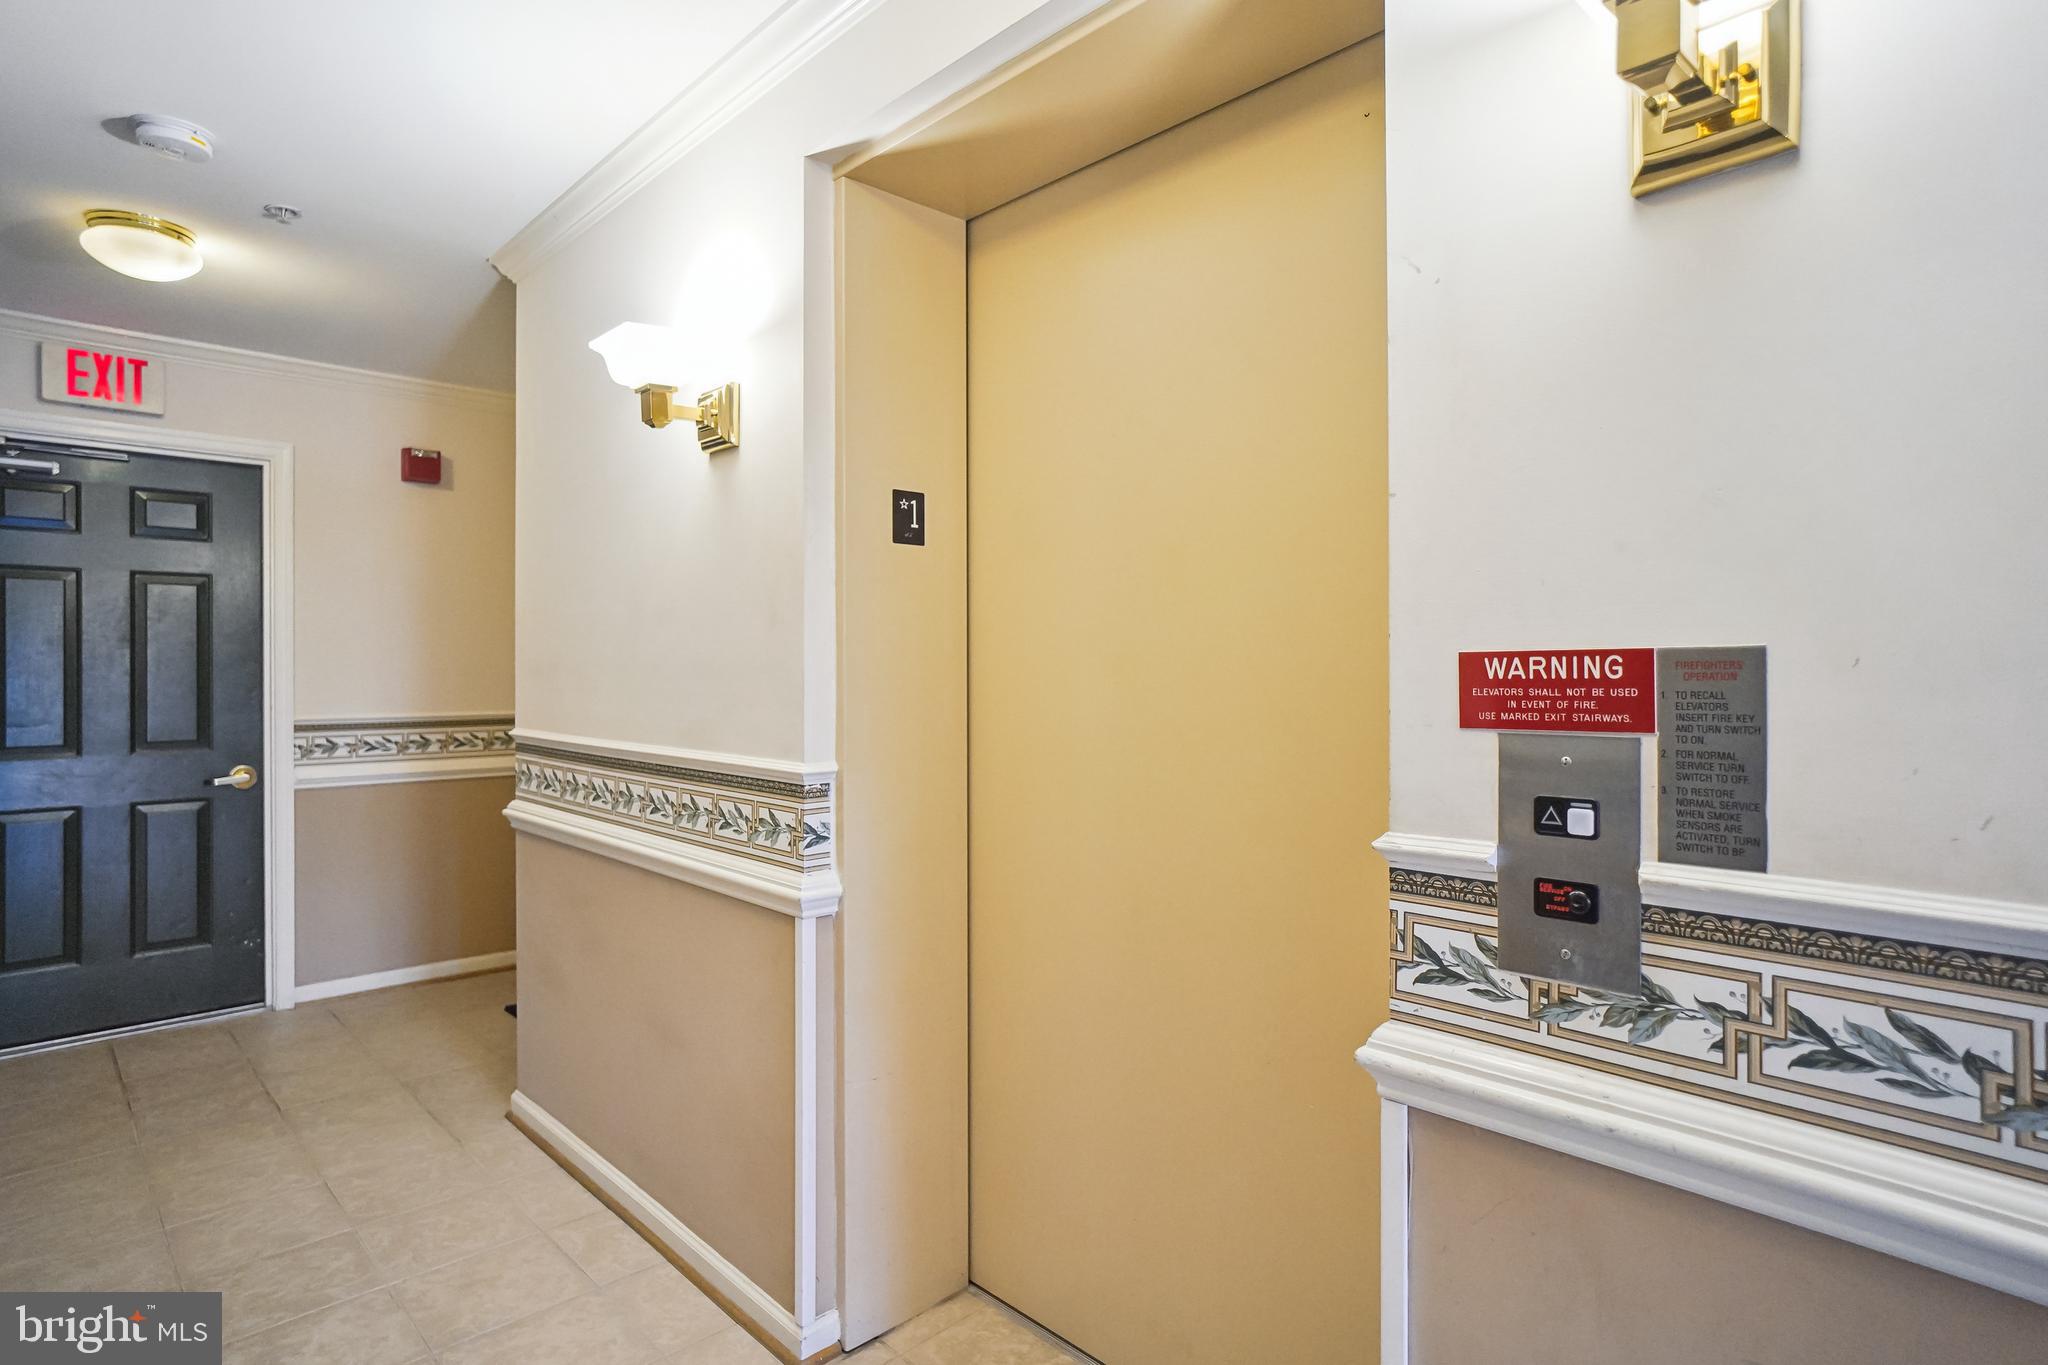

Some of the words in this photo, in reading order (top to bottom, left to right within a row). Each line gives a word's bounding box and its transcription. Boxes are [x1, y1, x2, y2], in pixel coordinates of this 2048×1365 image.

[66, 347, 148, 405] EXIT
[1484, 654, 1624, 680] WARNING
[1683, 671, 1738, 681] OPERATION
[1472, 687, 1524, 697] ELEVATORS
[1528, 687, 1562, 697] SHALL
[1566, 687, 1586, 697] NOT
[1592, 687, 1604, 697] BE
[1610, 687, 1638, 697] USED
[1675, 690, 1688, 700] TO
[1690, 690, 1726, 700] RECALL
[1507, 699, 1517, 709] IN
[1521, 700, 1550, 709] EVENT
[1556, 700, 1569, 709] OF
[1573, 700, 1599, 710] FIRE.
[1675, 701, 1729, 711] ELEVATORS
[1478, 711, 1496, 721] USE
[1501, 712, 1539, 721] MARKED
[1544, 713, 1566, 722] EXIT
[1572, 713, 1632, 724] STAIRWAYS.
[1675, 713, 1708, 722] INSERT
[1711, 713, 1734, 723] FIRE
[1736, 714, 1756, 723] KEY
[1675, 724, 1694, 733] AND
[1696, 724, 1721, 734] TURN
[1723, 725, 1761, 735] SWITCH
[1675, 735, 1688, 744] TO
[1675, 749, 1694, 759] FOR
[1696, 750, 1739, 761] NORMAL
[1675, 761, 1715, 771] SERVICE
[1718, 763, 1745, 773] TURN
[1675, 772, 1713, 783] SWITCH
[1715, 774, 1728, 783] TO
[1675, 786, 1688, 796] TO
[1690, 787, 1736, 799] RESTORE
[1675, 798, 1716, 809] NORMAL
[1719, 801, 1761, 812] SERVICE
[1675, 809, 1705, 819] WHEN
[1706, 811, 1743, 822] SMOKE
[1675, 820, 1721, 832] SENSORS
[1723, 823, 1743, 834] ARE
[1733, 836, 1760, 847] TURN
[1675, 842, 1713, 854] SWITCH
[1717, 846, 1730, 856] TO
